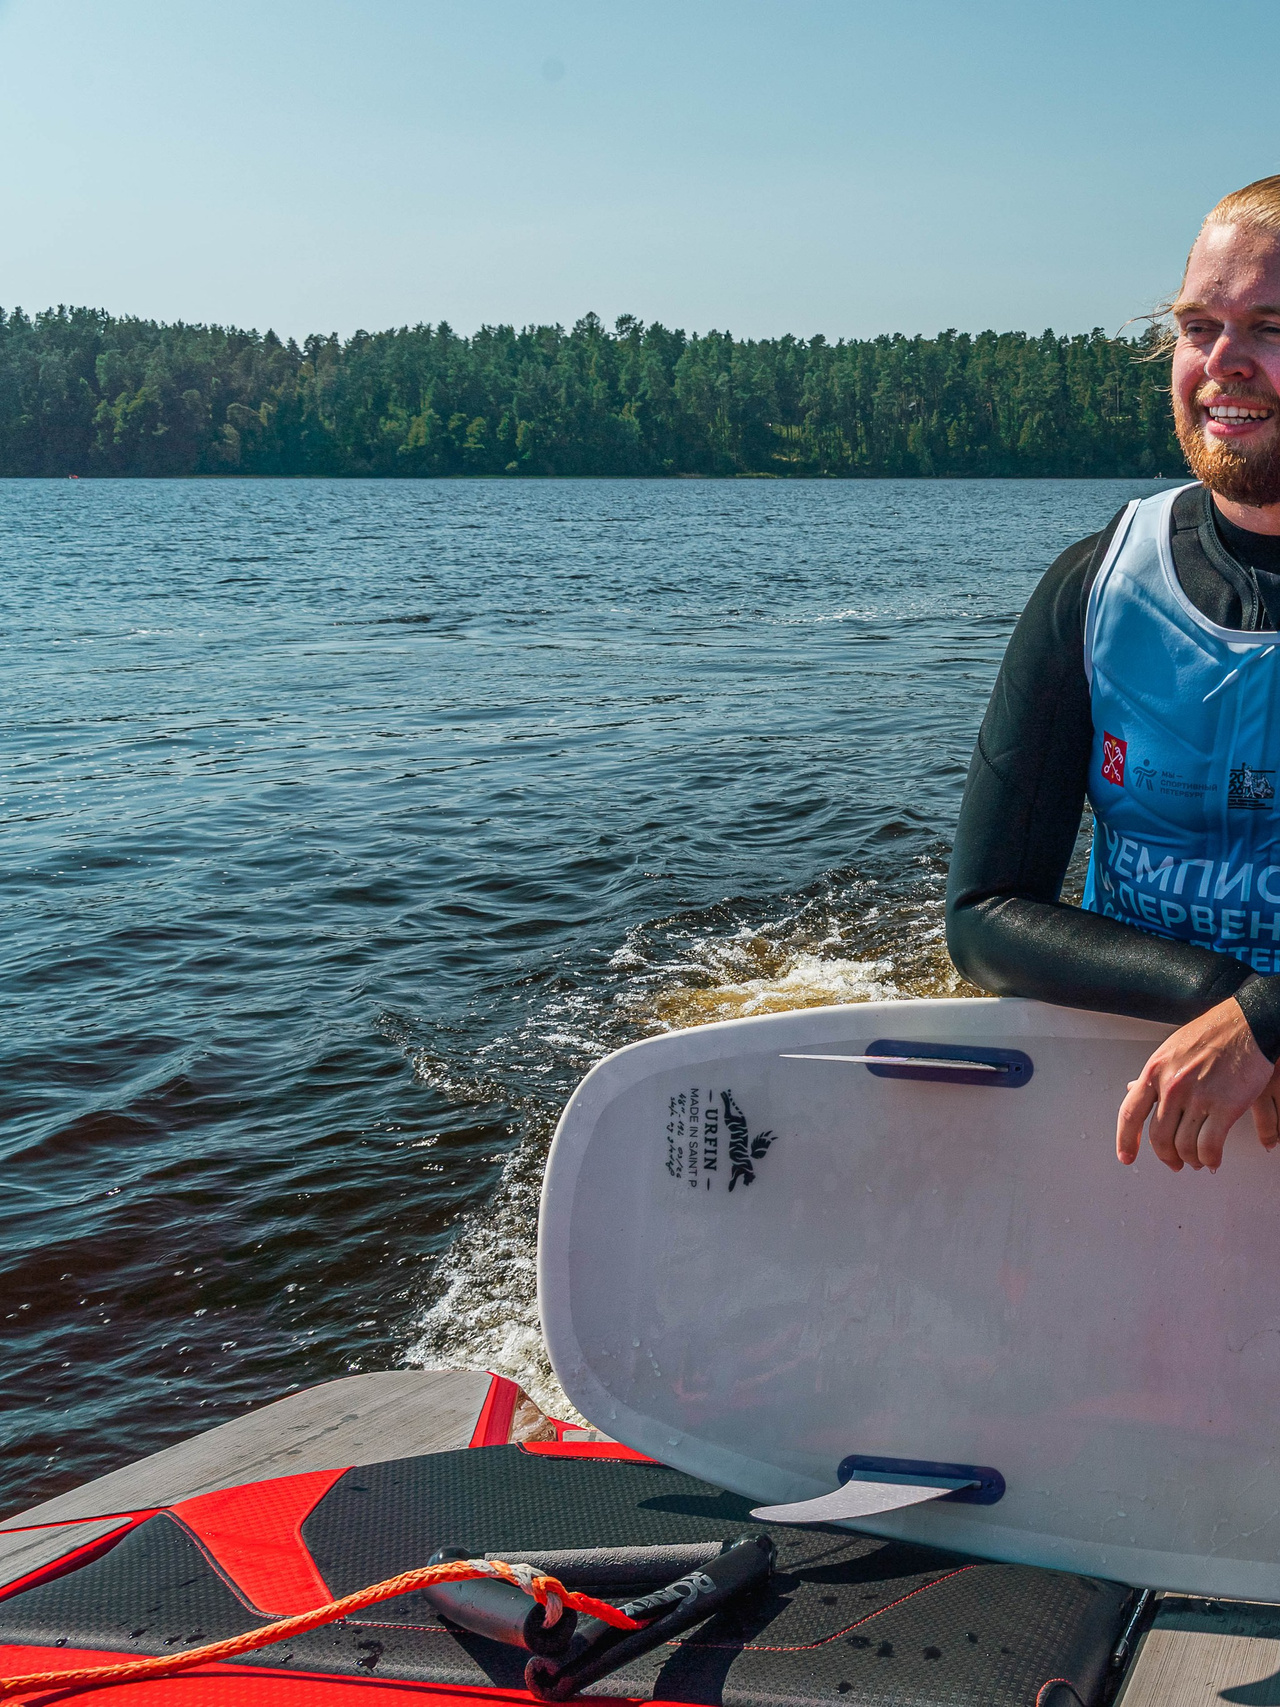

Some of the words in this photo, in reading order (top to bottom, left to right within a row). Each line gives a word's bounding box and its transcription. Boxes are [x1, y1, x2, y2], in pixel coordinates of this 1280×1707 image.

[1161, 770, 1174, 779] МЫ
[1229, 772, 1245, 784] 20
[1160, 779, 1218, 792] СПОРТИВНЫЙ
[1160, 787, 1206, 799] ПЕТЕРБУРГ
[689, 1088, 700, 1123] MADE
[689, 1126, 699, 1138] IN
[703, 1108, 719, 1171] URFIN
[688, 1141, 699, 1176] SAINT
